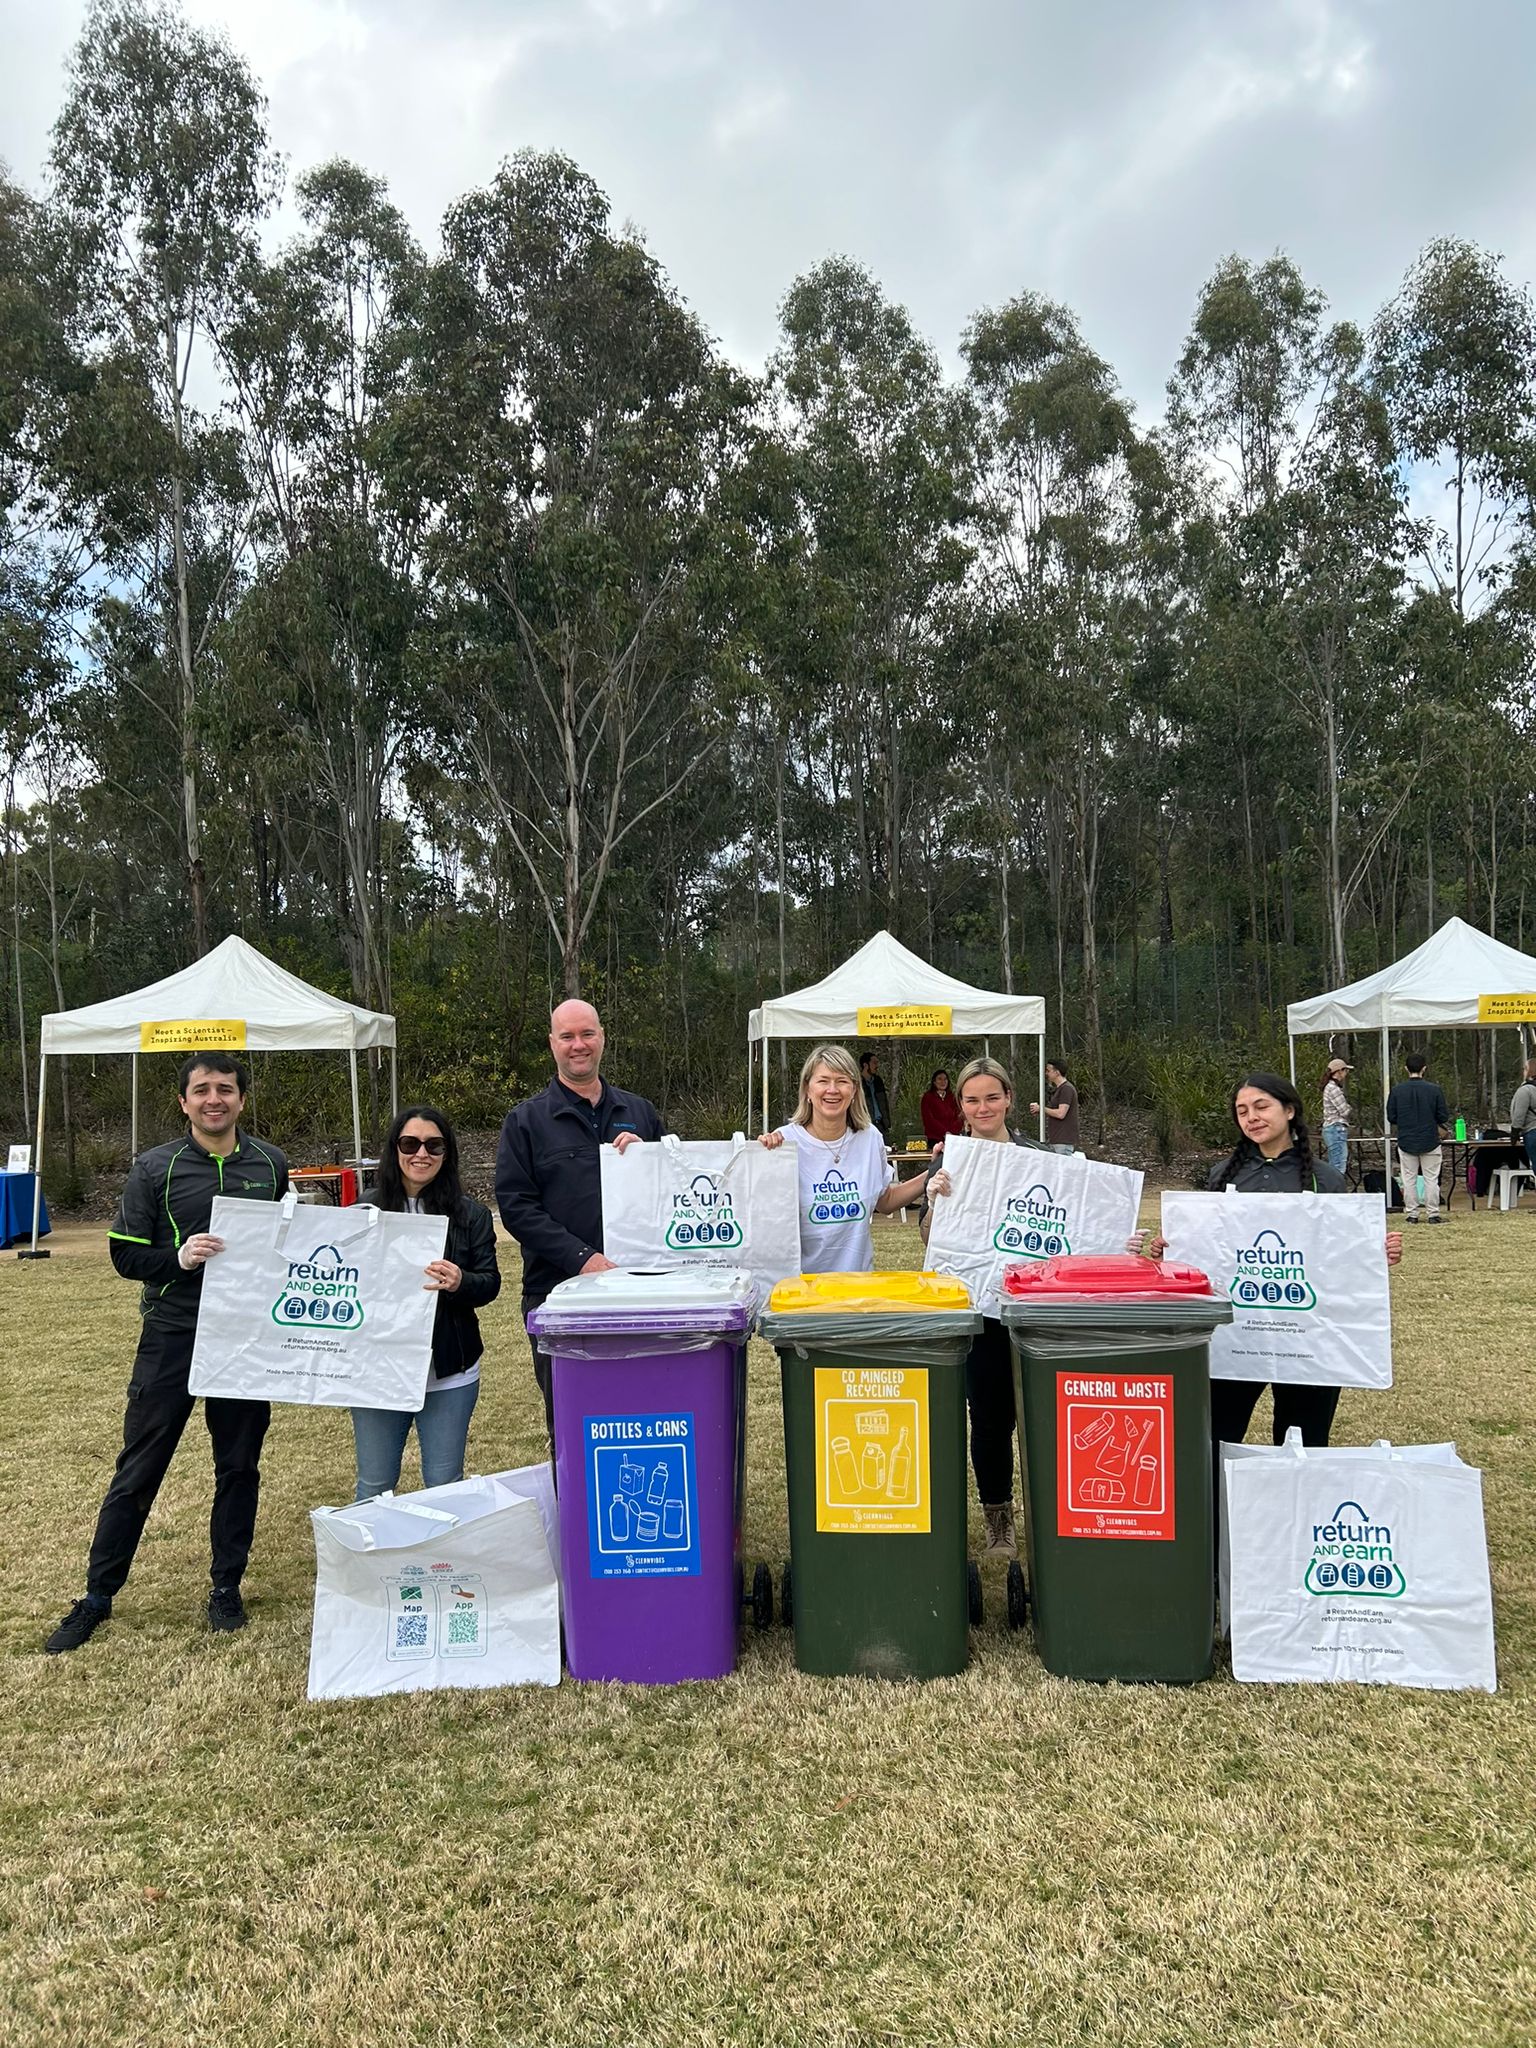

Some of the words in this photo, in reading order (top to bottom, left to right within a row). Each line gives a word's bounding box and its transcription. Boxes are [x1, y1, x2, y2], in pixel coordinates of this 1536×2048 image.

[813, 1181, 858, 1193] return
[831, 1192, 860, 1202] earn
[673, 1209, 696, 1218] AND
[1007, 1198, 1067, 1221] return
[1005, 1213, 1027, 1223] AND
[1028, 1217, 1065, 1234] earn
[1236, 1246, 1304, 1265] return
[288, 1262, 359, 1283] return
[1237, 1266, 1260, 1275] AND
[1261, 1266, 1305, 1280] earn
[285, 1281, 311, 1291] AND
[312, 1282, 357, 1298] earn
[842, 1371, 855, 1383] CO
[861, 1371, 904, 1384] MINGLED
[846, 1385, 900, 1397] RECYCLING
[1064, 1380, 1117, 1397] GENERAL
[1124, 1382, 1167, 1399] WASTE
[591, 1422, 642, 1439] BOTTLES
[646, 1426, 653, 1437] &
[656, 1421, 688, 1437] CANS
[1313, 1521, 1391, 1543] return
[1313, 1545, 1340, 1555] AND
[1342, 1544, 1392, 1561] earn
[404, 1605, 422, 1613] Map
[455, 1602, 473, 1610] App
